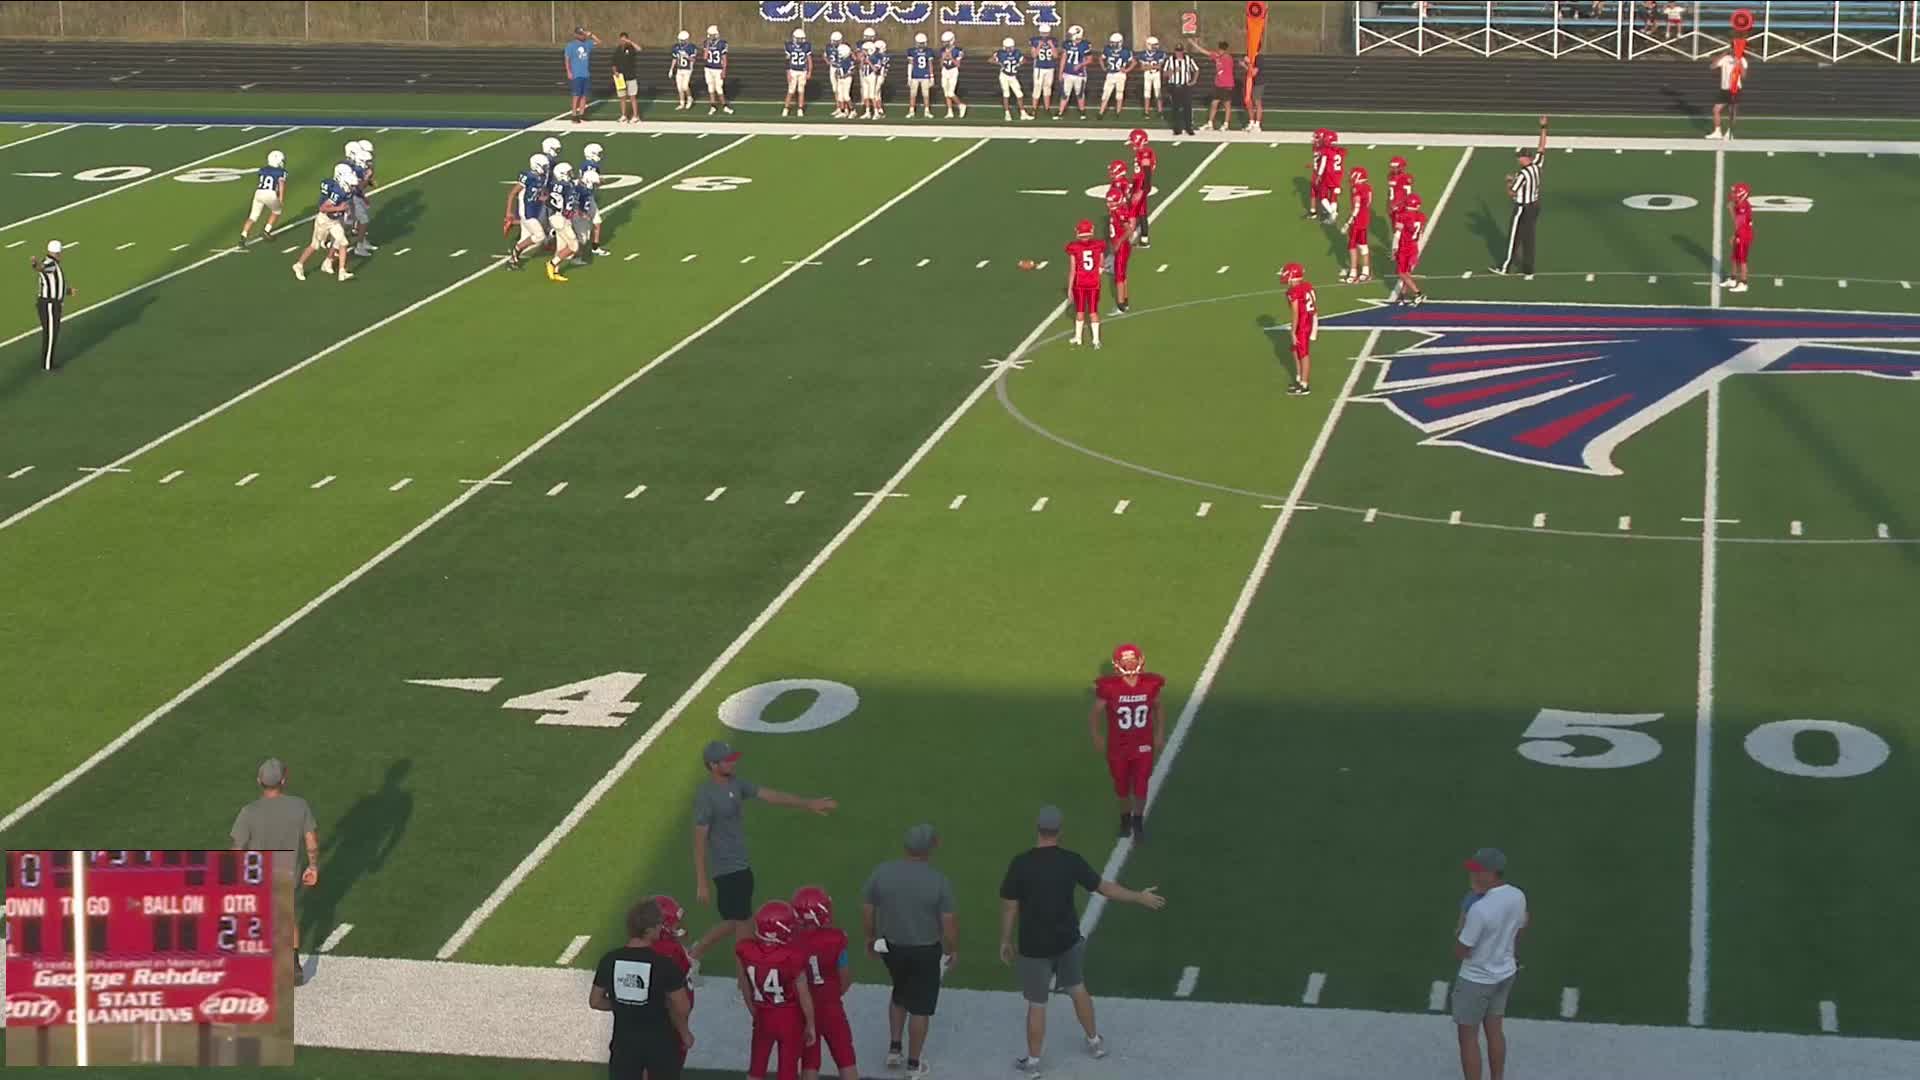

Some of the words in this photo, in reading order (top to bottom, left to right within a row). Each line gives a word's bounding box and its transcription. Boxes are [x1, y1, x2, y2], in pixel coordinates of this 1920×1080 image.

[1182, 11, 1197, 34] 2
[791, 52, 806, 65] 22
[917, 56, 926, 69] 9
[1066, 51, 1079, 65] 71
[1082, 250, 1094, 271] 5
[1117, 705, 1148, 729] 30
[244, 851, 262, 884] 8
[143, 895, 181, 914] BALL
[223, 895, 257, 913] QTR
[133, 968, 226, 985] Rehder
[746, 965, 785, 1004] 14
[98, 992, 163, 1007] STATE
[202, 997, 267, 1015] 2018
